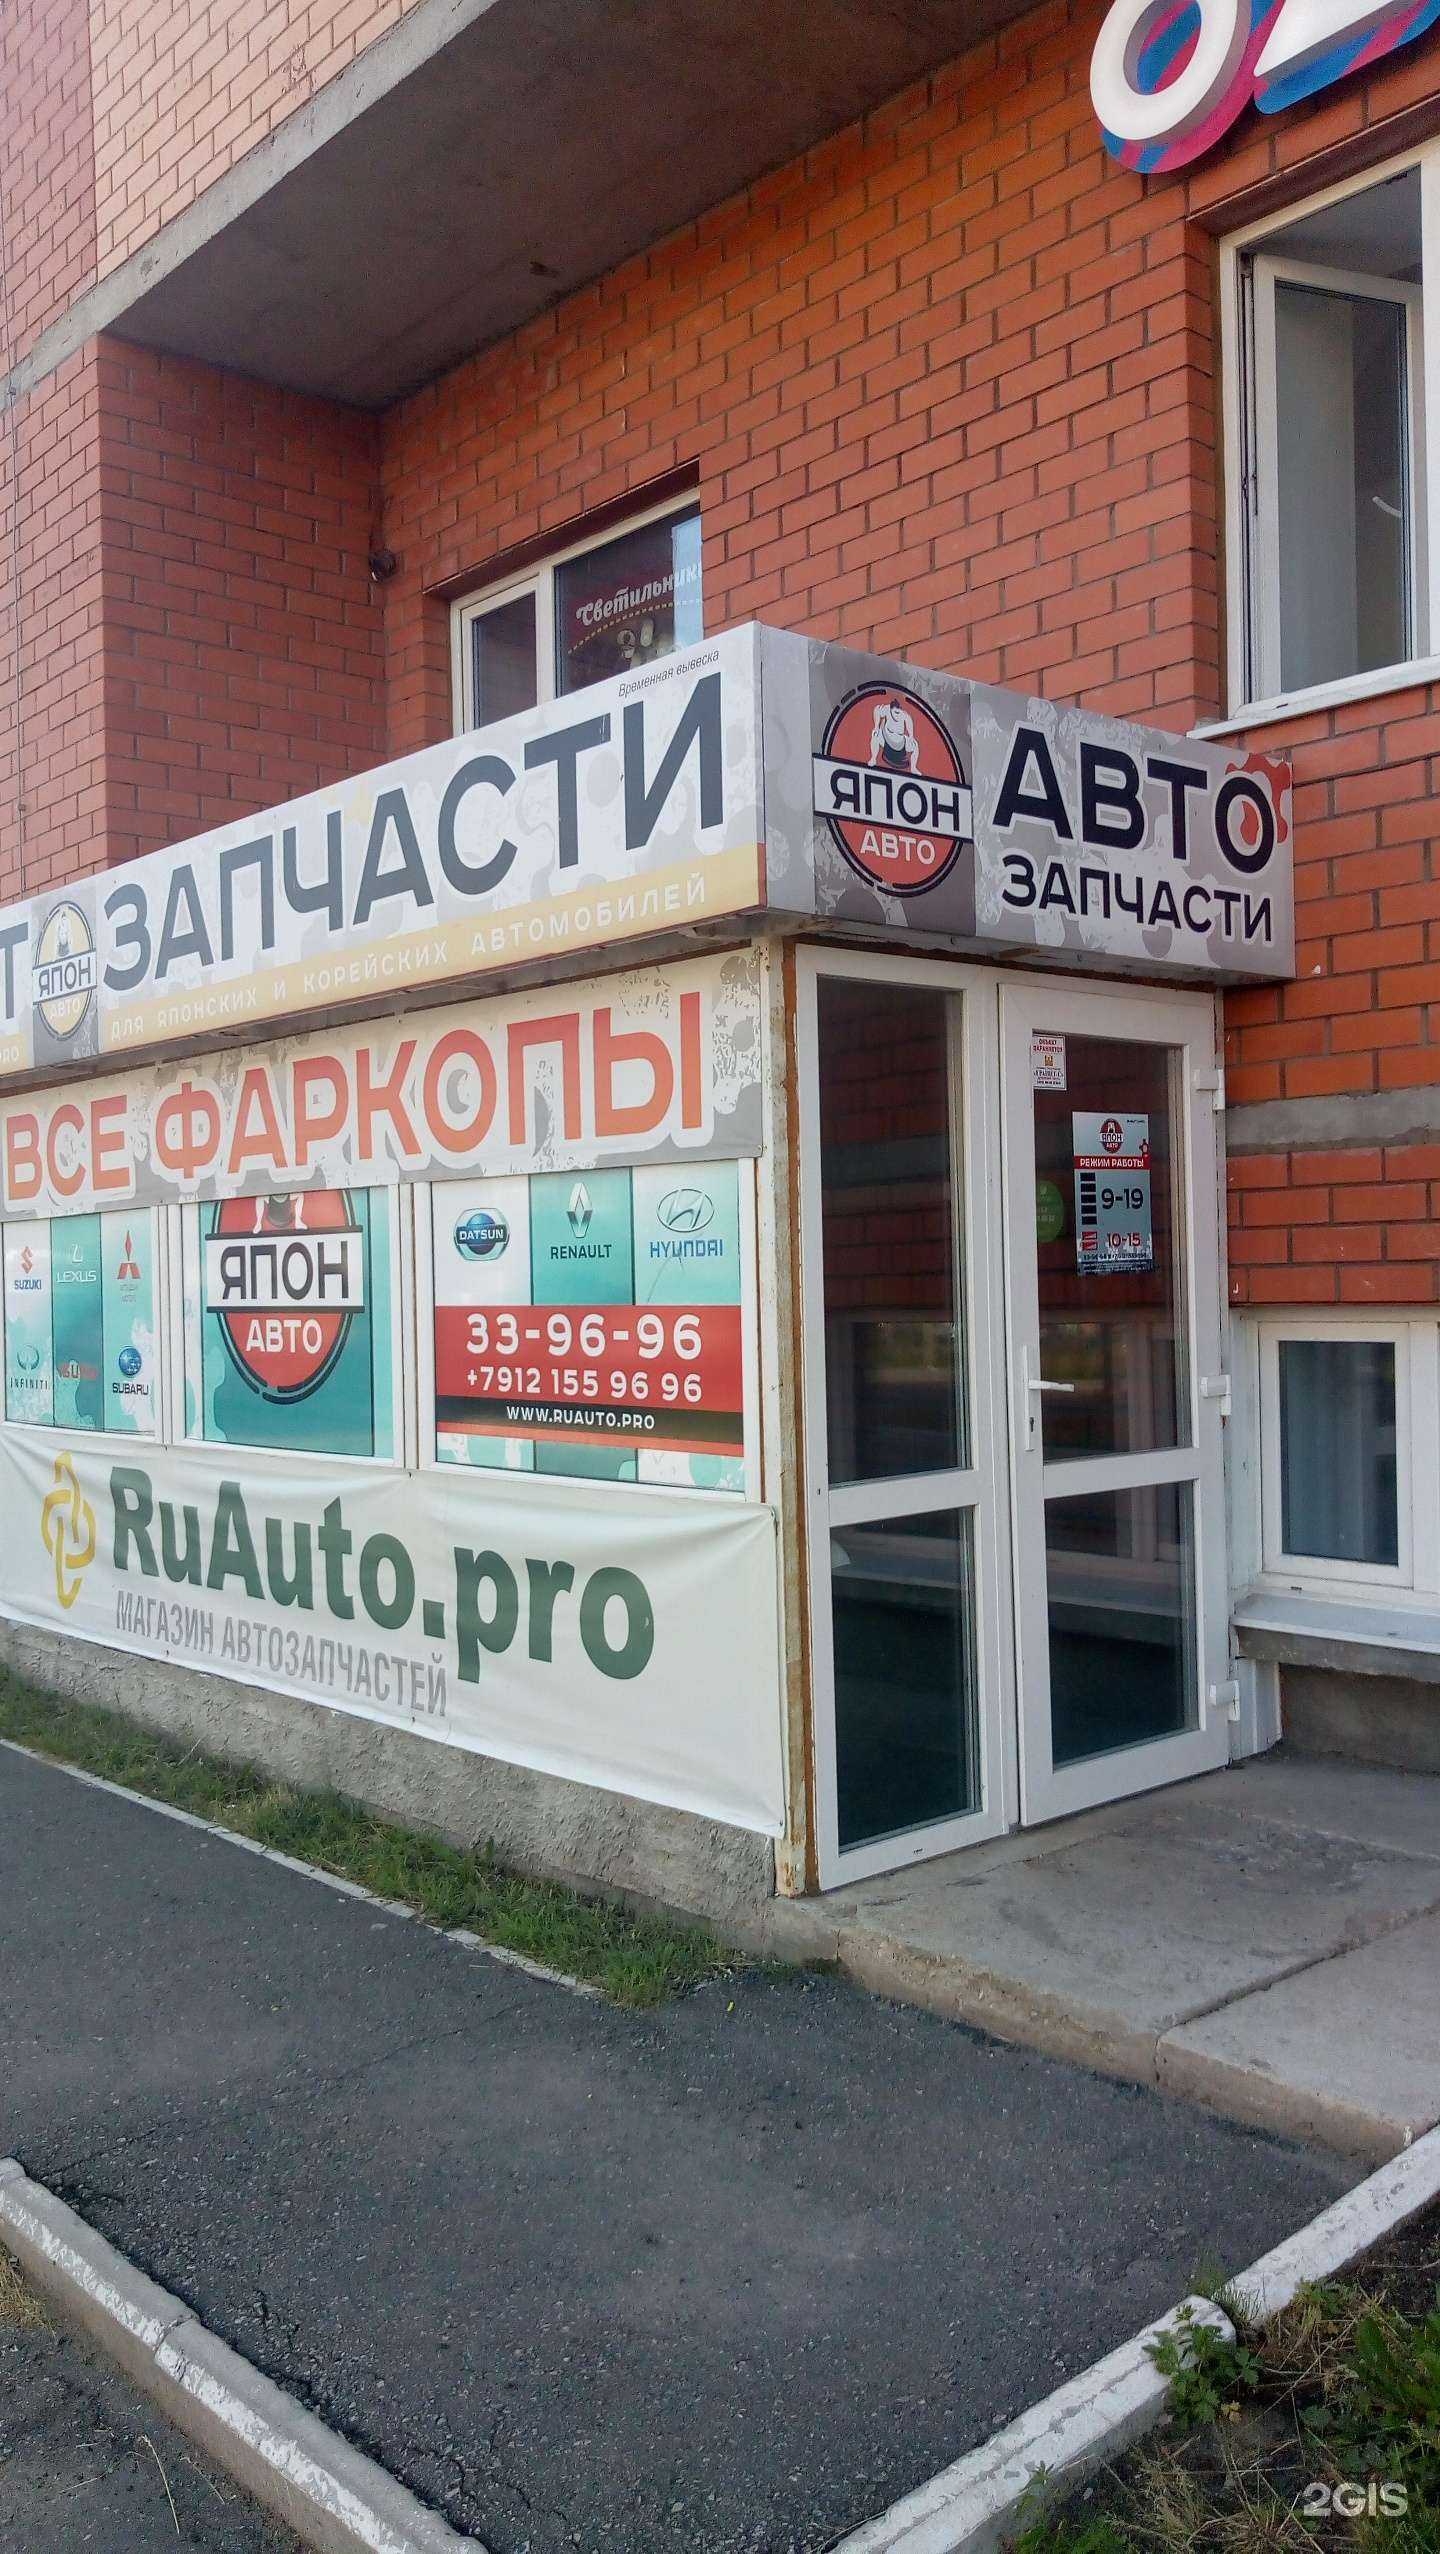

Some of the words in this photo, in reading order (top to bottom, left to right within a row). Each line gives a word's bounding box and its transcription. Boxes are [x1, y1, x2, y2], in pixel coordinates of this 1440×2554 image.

[618, 666, 674, 698] Временная
[676, 650, 720, 677] вывеска
[831, 767, 961, 832] ЯПОН
[992, 726, 1275, 874] АВТО
[103, 671, 724, 991] ЗАПЧАСТИ
[860, 829, 936, 866] АВТО
[1002, 854, 1272, 942] ЗАПЧАСТИ
[111, 1015, 144, 1042] ДЛЯ
[157, 987, 257, 1029] ЯПОНСКИХ
[272, 979, 287, 1001] И
[303, 940, 448, 994] КОРЕЙСКИХ
[471, 872, 706, 955] АВТОМОБИЛЕЙ
[38, 957, 91, 998] ЯПОН
[50, 998, 81, 1019] АВТО
[6, 1094, 131, 1200] ВСЕ
[154, 994, 702, 1179] ФАРКОПЫ
[1080, 1158, 1110, 1167] РЕЖИМ
[1111, 1158, 1144, 1168] РАБОТЫ
[1101, 1188, 1144, 1209] 9-19
[459, 1228, 505, 1242] DATSUN
[550, 1243, 612, 1260] RENAULT
[649, 1238, 723, 1259] HYUNDAI
[1107, 1232, 1141, 1247] 10-15
[14, 1279, 42, 1290] SUZUKI
[56, 1270, 97, 1283] LEXUS
[220, 1240, 349, 1300] ЯПОН
[246, 1319, 323, 1354] АВТО
[466, 1313, 702, 1361] 33-96-96
[9, 1377, 49, 1391] INFINITI
[112, 1382, 149, 1396] SUBARU
[467, 1366, 542, 1394] +7912
[551, 1368, 599, 1398] 155
[610, 1370, 649, 1400] 96
[661, 1373, 702, 1403] 96
[506, 1405, 655, 1430] WWW.RUAUTO.PRO
[109, 1466, 655, 1684] RuAuto.pro
[116, 1590, 214, 1654] МАГАЗИН
[222, 1615, 449, 1718] АВТОЗАПЧАСТЕЙ
